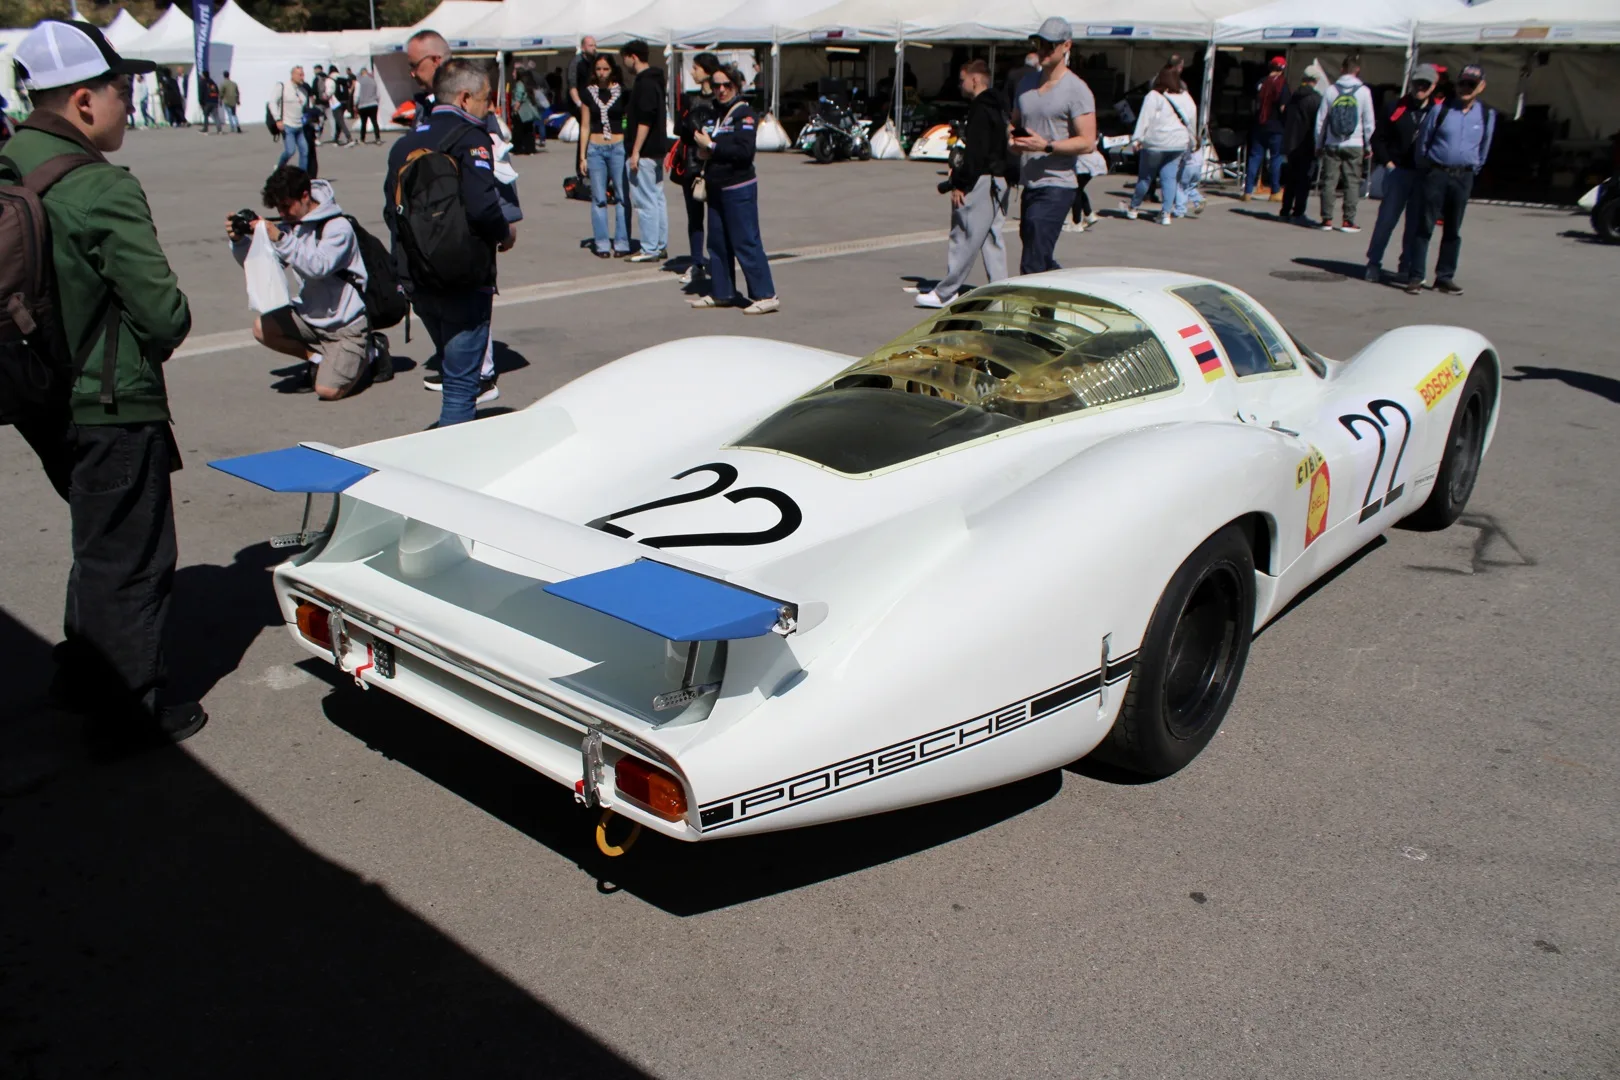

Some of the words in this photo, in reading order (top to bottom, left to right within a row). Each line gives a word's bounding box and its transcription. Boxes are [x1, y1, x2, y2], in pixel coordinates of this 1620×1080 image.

[1420, 366, 1454, 406] BOSCH
[584, 462, 802, 549] 22
[1338, 399, 1411, 525] 22
[740, 704, 1026, 815] PORSCHE
